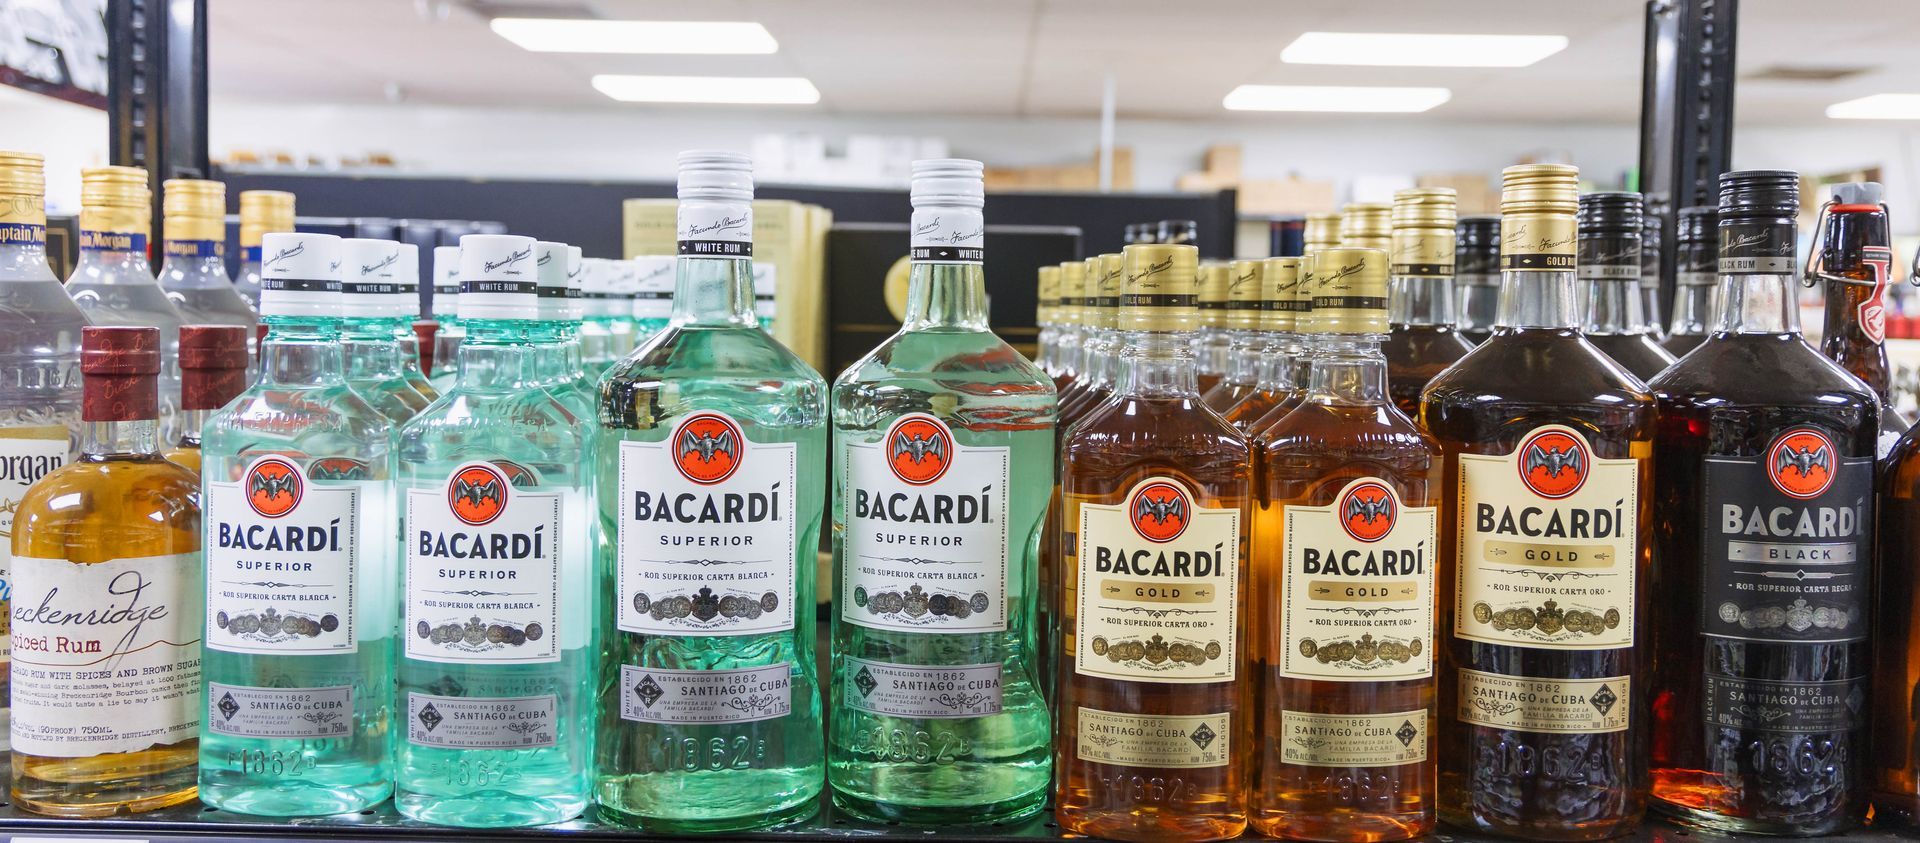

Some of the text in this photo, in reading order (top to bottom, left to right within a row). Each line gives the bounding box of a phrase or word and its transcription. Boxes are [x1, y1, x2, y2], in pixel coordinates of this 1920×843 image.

[694, 242, 740, 253] WHITE RUM
[916, 249, 930, 258] RUM
[958, 249, 979, 259] WHITE
[1546, 257, 1566, 266] GOLD
[1737, 260, 1755, 269] RUM
[356, 284, 378, 292] WHITE
[479, 283, 519, 291] WHITE RUM
[1137, 296, 1152, 304] RUM
[1329, 298, 1344, 306] RUM
[635, 481, 781, 524] BACARDÍ
[855, 483, 992, 524] BACARDÍ
[1476, 498, 1624, 539] BACARDÍ
[1722, 496, 1864, 538] BACARDÍ
[219, 517, 341, 552] BACARDÍ
[876, 532, 963, 547] SUPERIOR
[419, 523, 545, 560] BACARDÍ
[660, 535, 753, 547] SUPERIOR
[1096, 541, 1224, 577] BACARDÍ
[1303, 540, 1424, 577] BACARDÍ
[1525, 549, 1578, 562] GOLD
[1769, 548, 1832, 560] BLACK
[236, 560, 313, 571] SUPERIOR
[438, 568, 517, 580] SUPERIOR
[644, 571, 768, 582] RON SUPERIOR CARTA BLANCA
[862, 566, 978, 580] RON SUPERIOR CARTA BLANCA
[1135, 587, 1180, 598] GOLD
[1345, 587, 1389, 597] GOLD
[1493, 583, 1605, 596] RON SUPERIOR CARTA ORO
[1736, 582, 1755, 591] RON
[1757, 583, 1801, 593] SUPERIOR
[1803, 585, 1830, 594] CARTA
[223, 590, 235, 599] RON
[236, 592, 270, 601] SUPERIOR
[424, 599, 534, 610] RON SUPERIOR CARTA BLANCA
[12, 571, 168, 668] eckenridge
[1106, 617, 1208, 628] RON SUPERIOR CARTA ORO
[1315, 618, 1332, 627] RON
[1334, 619, 1372, 627] SUPERIOR
[1373, 619, 1397, 627] CARTA
[56, 637, 102, 653] Rum
[30, 670, 46, 679] RUM
[49, 672, 72, 680] WITH
[76, 670, 112, 680] SPICES
[116, 669, 138, 678] AND
[142, 664, 174, 675] BROWN
[872, 668, 920, 678] ESTABLECIDO
[936, 671, 965, 681] 1862
[658, 675, 711, 683] ESTABLECIDO
[727, 674, 757, 685] 1862
[892, 679, 955, 692] SANTIAGO
[968, 679, 1000, 691] CUBA
[1462, 674, 1513, 687] ESTABLECIDO
[1530, 682, 1561, 694] 1862
[116, 688, 148, 697] Bourbon
[681, 684, 746, 696] SANTIAGO
[759, 678, 789, 692] CUBA
[1793, 687, 1822, 696] 1862
[233, 692, 273, 700] ESTABLECIDO
[286, 694, 311, 702] 1862
[1472, 686, 1536, 703] SANTIAGO
[1551, 694, 1586, 705] CUBA
[1729, 691, 1798, 706] SANTIAGO
[1811, 695, 1841, 706] CUBA
[250, 701, 301, 710] SANTIAGO
[313, 700, 343, 710] CUBA
[490, 704, 516, 712] 1862
[454, 711, 507, 720] SANTIAGO
[518, 710, 547, 720] CUBA
[1080, 712, 1123, 723] ESTABLECIDO
[1137, 719, 1164, 728] 1862
[1284, 715, 1332, 725] ESTABLECIDO
[1345, 719, 1372, 727] 1862
[81, 726, 112, 734] 750ML
[1089, 723, 1144, 737] SANTIAGO
[1156, 729, 1186, 738] CUBA
[1294, 725, 1352, 737] SANTIAGO
[1364, 727, 1392, 737] CUBA
[661, 735, 751, 773] 1862
[1500, 742, 1585, 783] 1862
